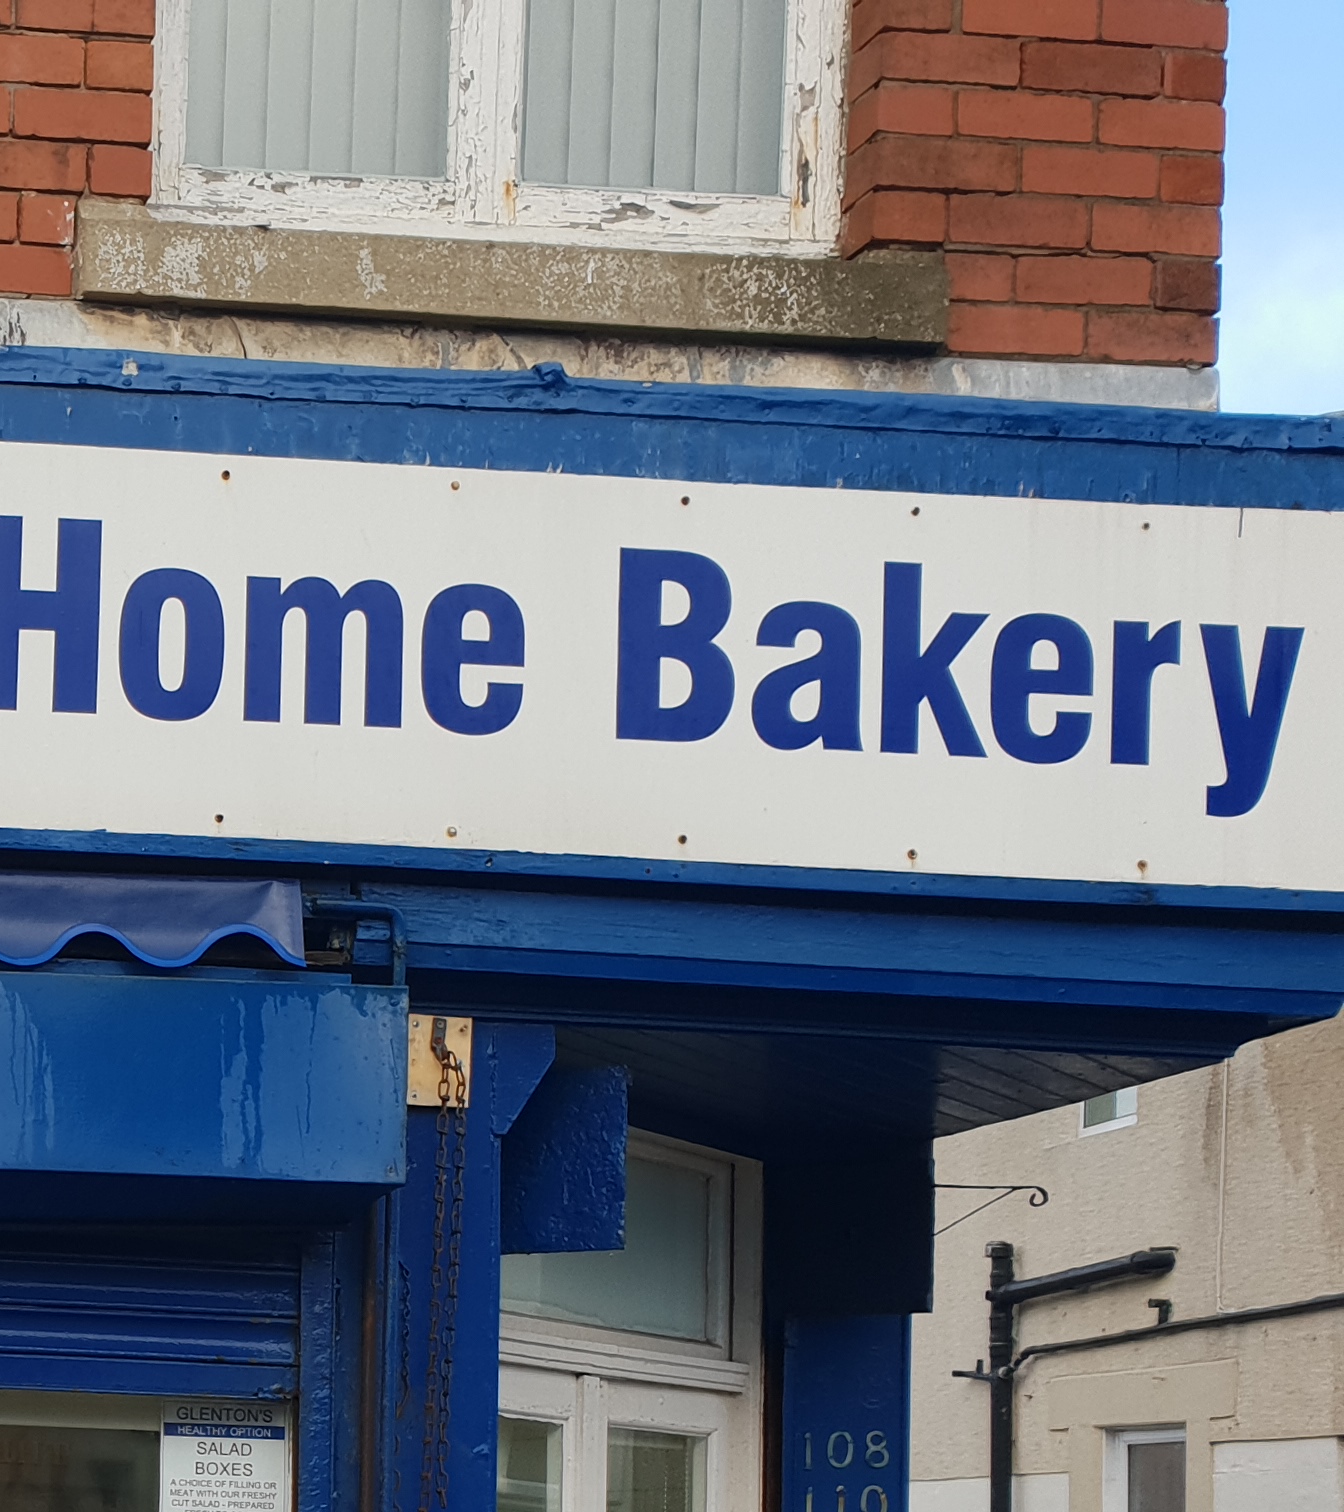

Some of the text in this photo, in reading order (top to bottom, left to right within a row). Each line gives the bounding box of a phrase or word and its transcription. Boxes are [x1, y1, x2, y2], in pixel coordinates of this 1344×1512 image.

[615, 547, 1305, 818] Bakery
[177, 1406, 273, 1422] GLENTON'S
[177, 1426, 271, 1437] HEALTHY OPTION
[196, 1442, 252, 1456] SALAD
[803, 1430, 890, 1470] 108
[195, 1462, 253, 1476] BOXES
[179, 1479, 212, 1487] CHOICE
[229, 1481, 261, 1489] FILLING
[264, 1482, 277, 1490] OR
[170, 1489, 194, 1497] MEAT
[196, 1490, 218, 1498] WITH
[172, 1499, 190, 1507] CUT
[192, 1500, 220, 1508] SALAD
[228, 1501, 274, 1510] PREPARED
